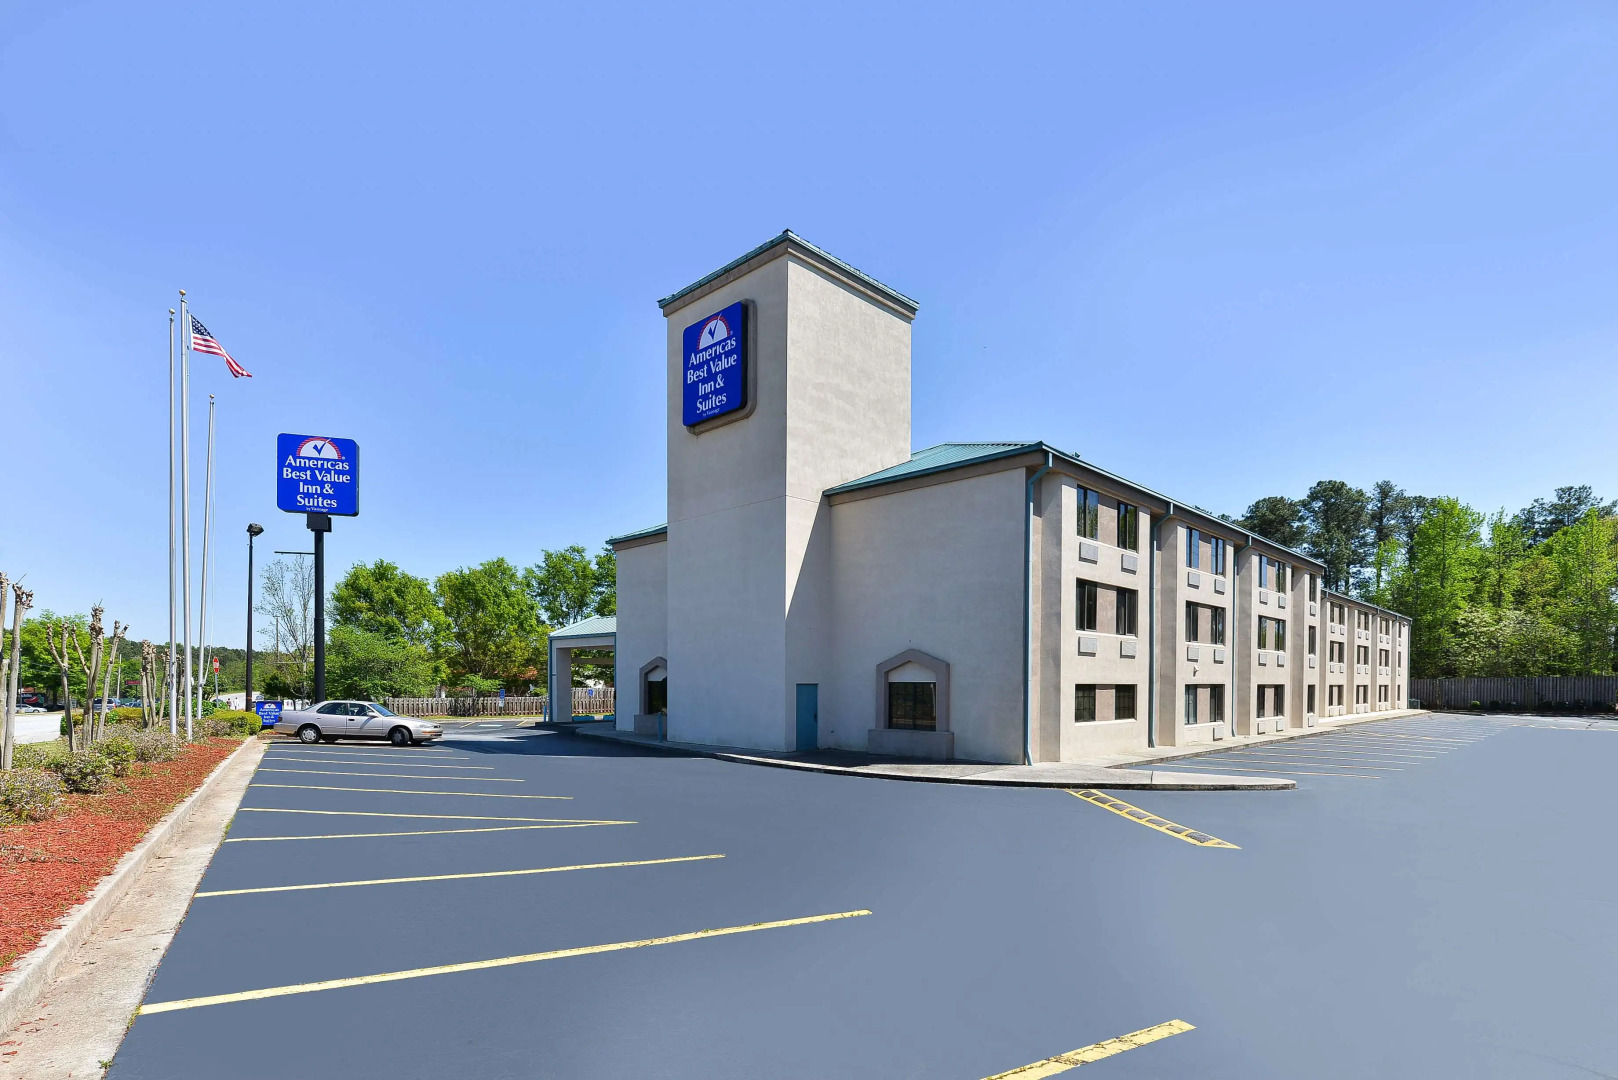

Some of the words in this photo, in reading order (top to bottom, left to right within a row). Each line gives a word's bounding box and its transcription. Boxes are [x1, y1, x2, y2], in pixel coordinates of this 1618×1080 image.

[689, 337, 736, 367] Americas
[687, 364, 708, 384] Best
[710, 354, 737, 374] Value
[698, 381, 715, 396] Inn
[715, 374, 725, 389] &
[696, 393, 727, 414] Suites
[285, 454, 350, 471] Americas
[283, 467, 312, 480] Best
[315, 470, 351, 483] Value
[299, 481, 321, 494] Inn
[323, 483, 335, 494] &
[296, 494, 337, 508] Suites
